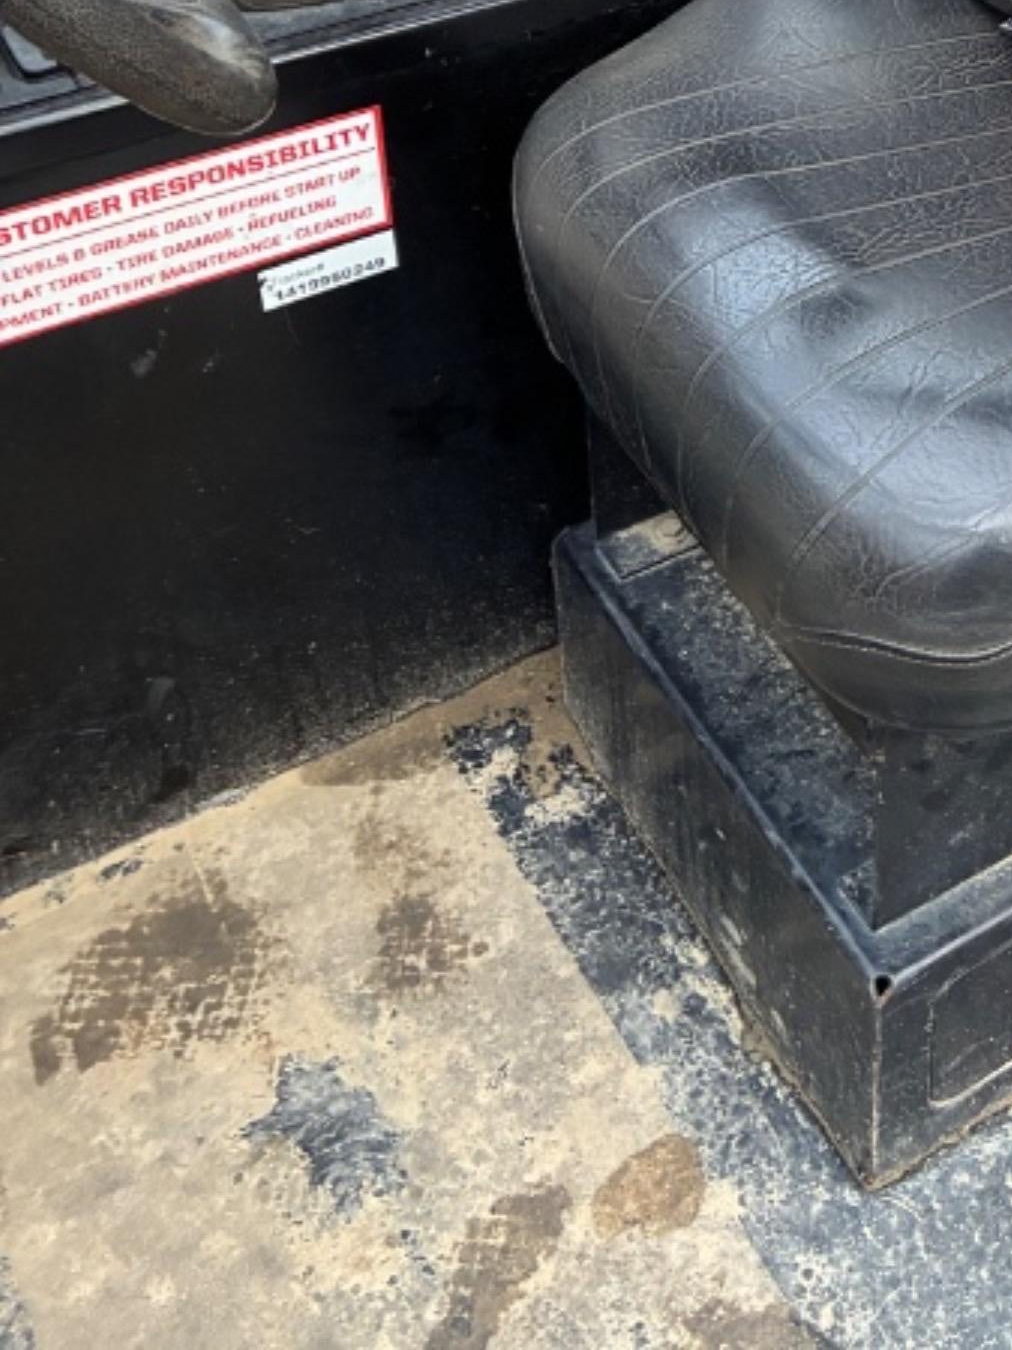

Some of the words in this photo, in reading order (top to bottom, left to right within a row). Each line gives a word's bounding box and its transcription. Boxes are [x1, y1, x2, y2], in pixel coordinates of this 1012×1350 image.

[130, 123, 370, 208] RESPONSIBILITY
[0, 284, 44, 308] FLAT
[116, 249, 159, 271] TIRE
[161, 227, 235, 259] DAMAGE
[248, 195, 337, 232] REFUELING
[1, 253, 69, 283] LEVELS
[90, 227, 160, 256] GREASE
[164, 210, 213, 235] DAILY
[218, 190, 282, 218] BEFORE
[284, 174, 335, 199] START
[338, 167, 361, 183] UP
[78, 273, 156, 307] BATTERY
[160, 235, 283, 283] MAINTENANCE
[294, 206, 375, 241] CLEANING
